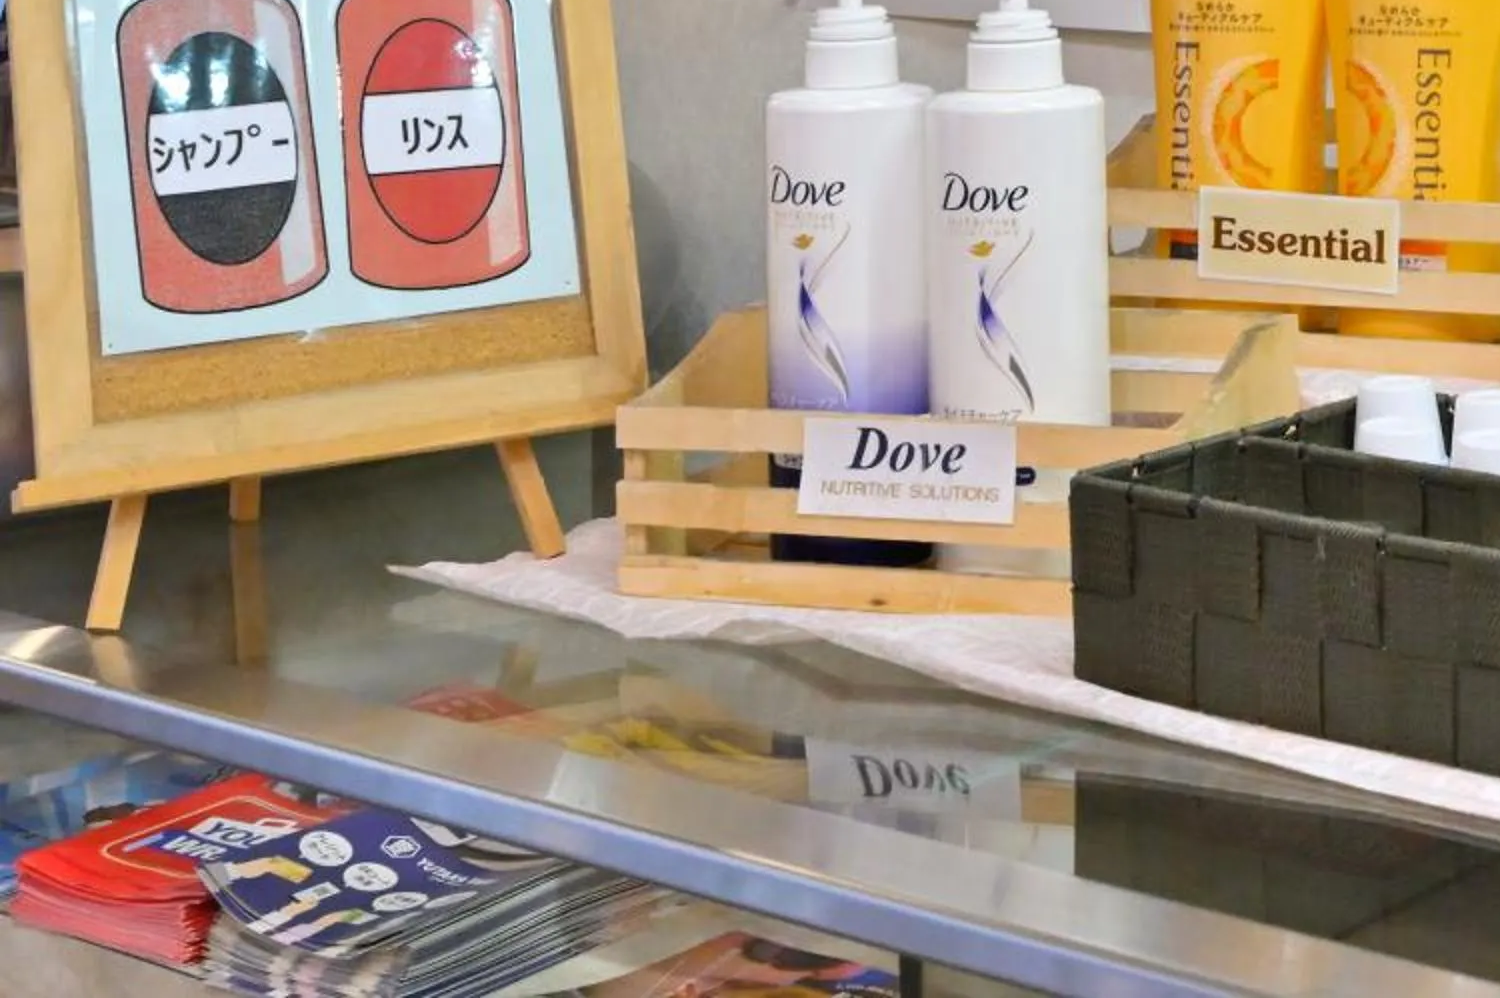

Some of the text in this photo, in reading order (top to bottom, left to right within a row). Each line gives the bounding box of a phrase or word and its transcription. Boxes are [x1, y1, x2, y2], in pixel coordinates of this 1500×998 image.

[153, 122, 290, 174] シャンプー
[401, 113, 469, 156] リンス
[771, 165, 845, 206] Dove
[942, 171, 1029, 212] Dove
[1212, 216, 1387, 264] Essential
[848, 427, 966, 474] Dove
[820, 480, 1000, 503] NUTRITIVE SOLUTIONS
